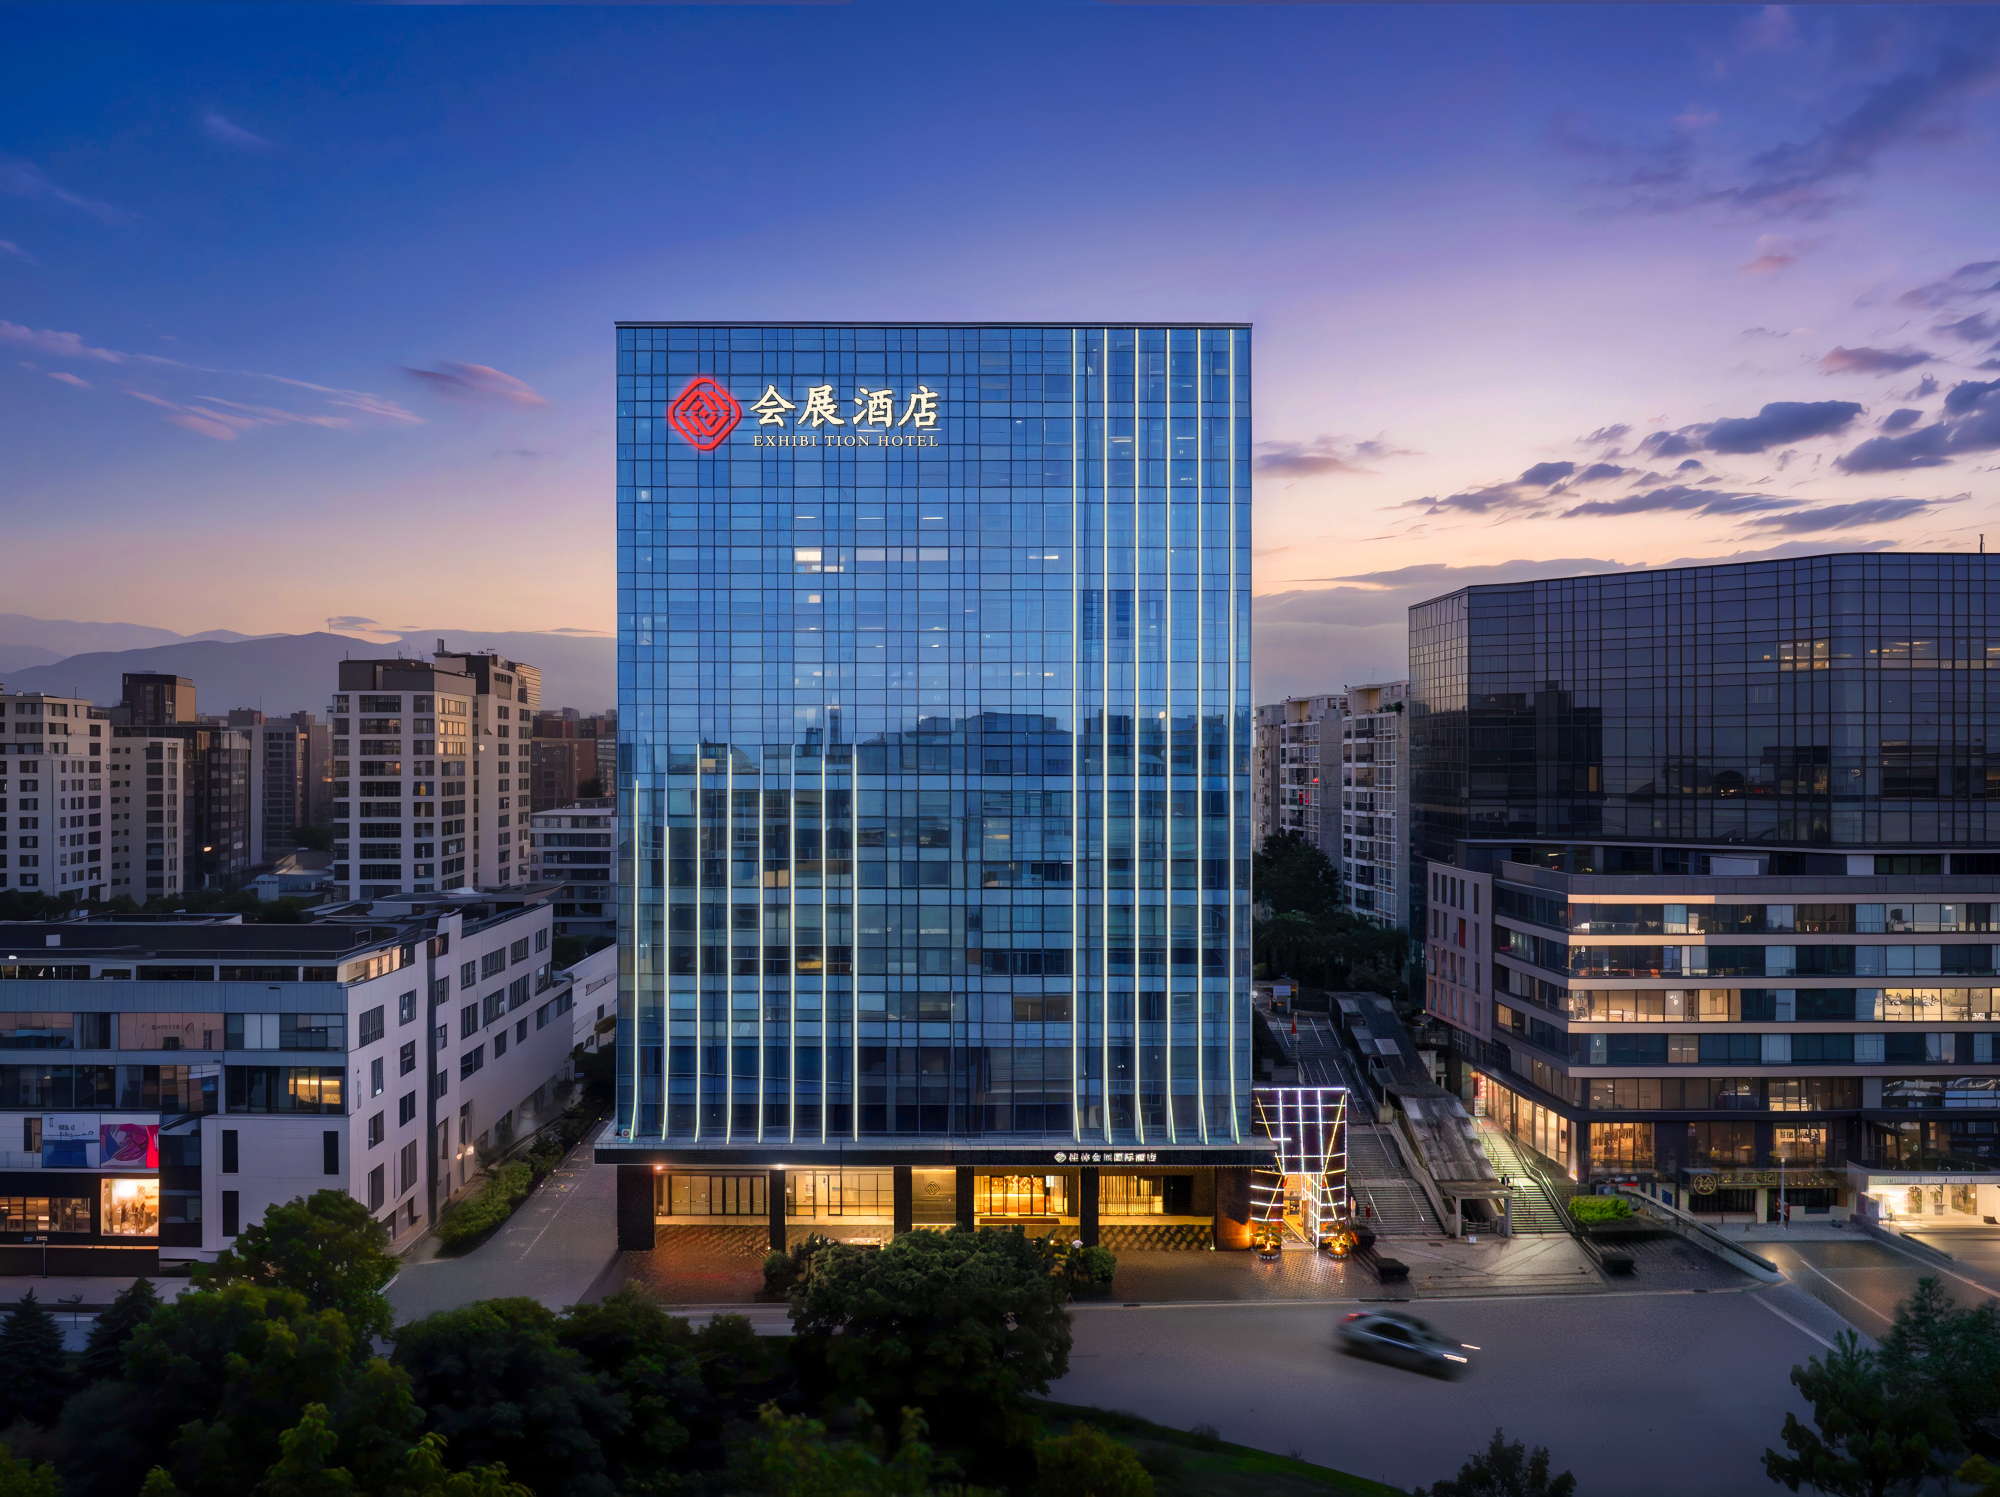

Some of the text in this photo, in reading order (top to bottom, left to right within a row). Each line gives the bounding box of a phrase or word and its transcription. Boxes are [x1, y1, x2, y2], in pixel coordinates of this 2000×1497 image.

[750, 384, 938, 428] 会展酒店
[877, 435, 939, 447] HOTEL
